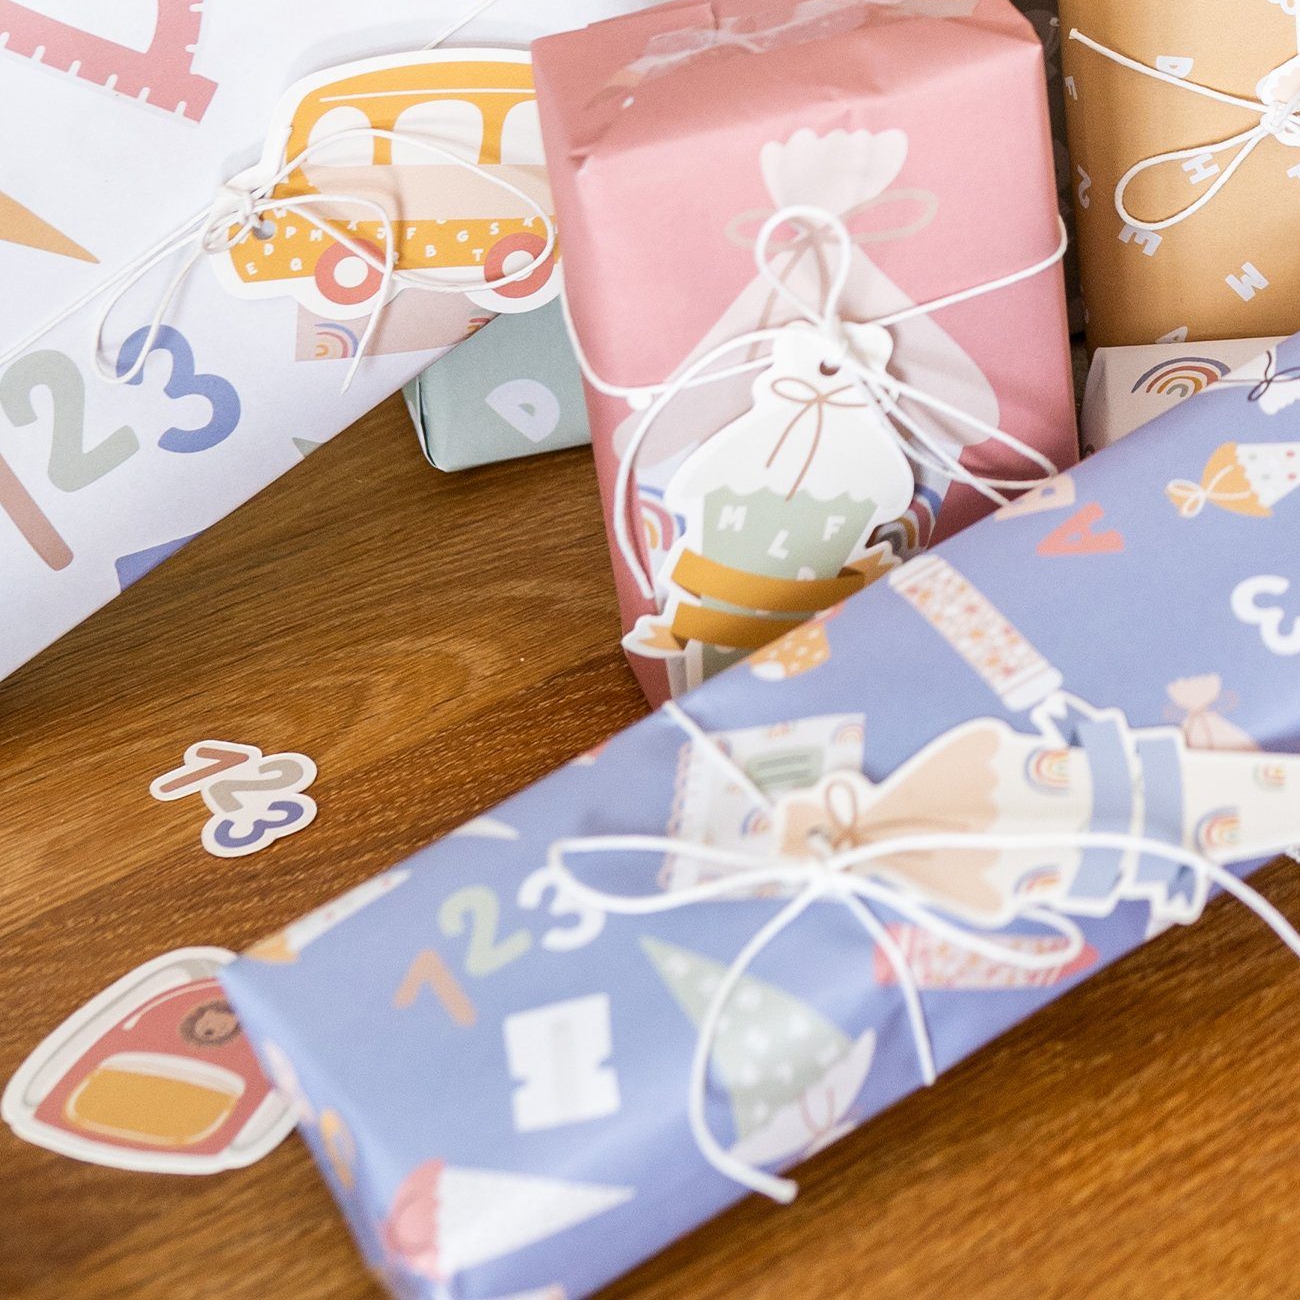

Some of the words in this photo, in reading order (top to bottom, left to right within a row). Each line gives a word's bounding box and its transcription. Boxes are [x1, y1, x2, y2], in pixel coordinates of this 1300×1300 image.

[1180, 153, 1220, 185] H
[1225, 261, 1269, 301] M
[484, 378, 561, 444] D
[717, 505, 748, 532] M
[823, 515, 846, 542] F
[1036, 502, 1125, 558] A
[767, 530, 790, 560] L
